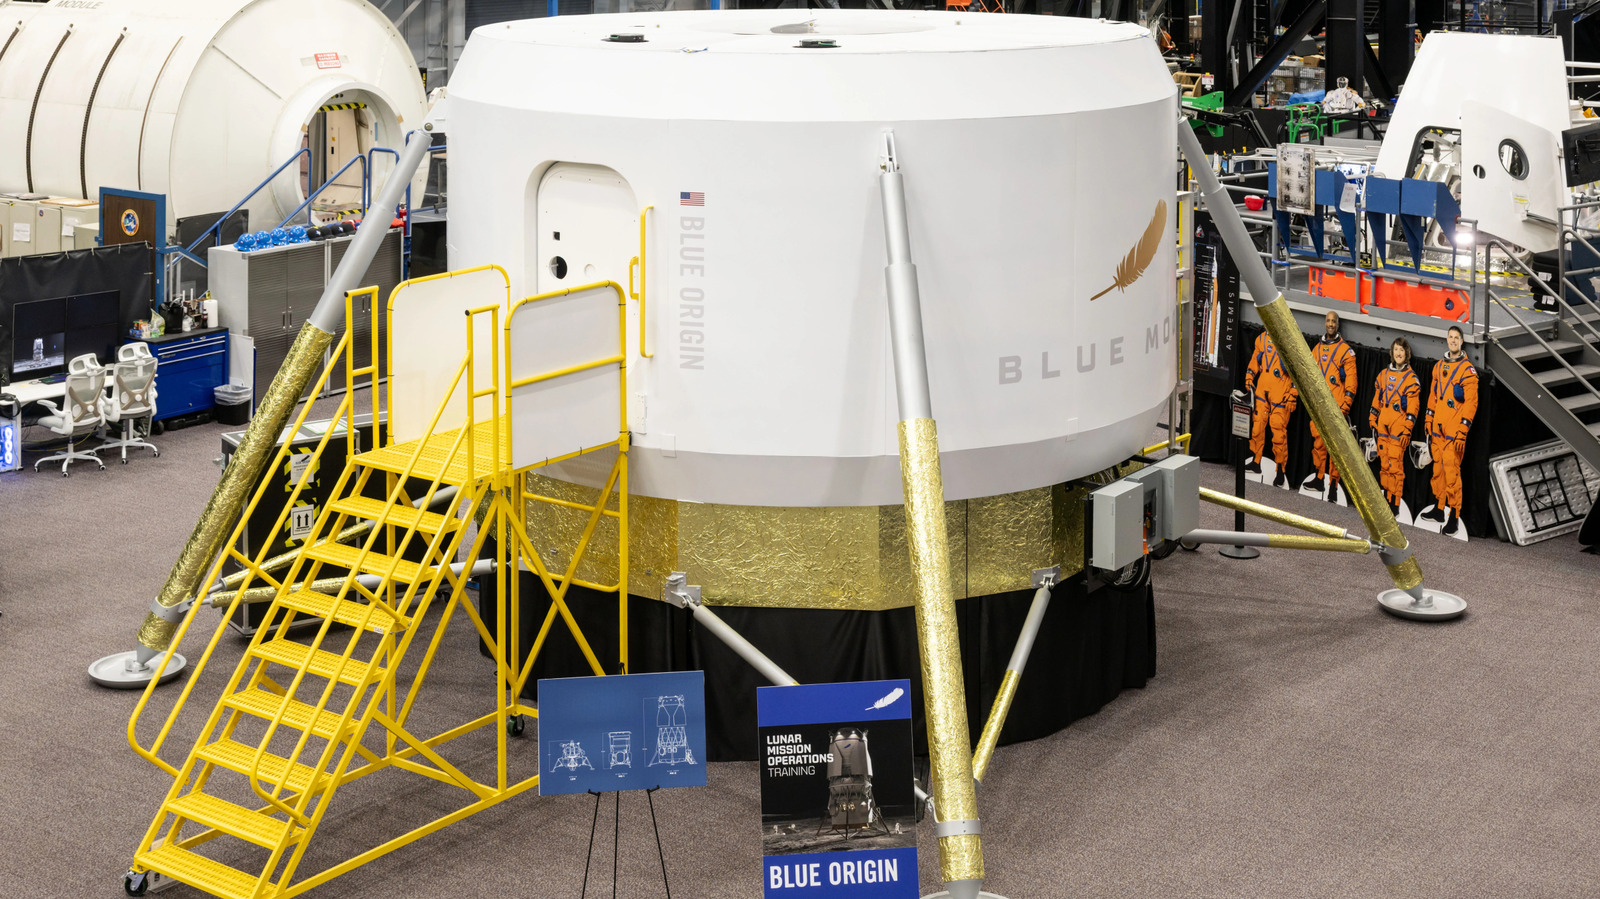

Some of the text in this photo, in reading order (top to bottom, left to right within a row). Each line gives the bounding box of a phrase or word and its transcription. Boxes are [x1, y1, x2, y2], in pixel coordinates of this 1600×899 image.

[55, 0, 104, 9] MODULE
[679, 216, 705, 370] BLUE ORIGIN
[1226, 292, 1235, 350] ARTEMIS
[998, 336, 1124, 385] BLUE
[1145, 313, 1176, 354] MO
[766, 734, 802, 745] LUNAR
[767, 744, 812, 755] MISSION
[767, 753, 834, 766] OPERATIONS
[768, 765, 816, 777] TRAINING
[769, 858, 898, 889] BLUE ORIGIN
